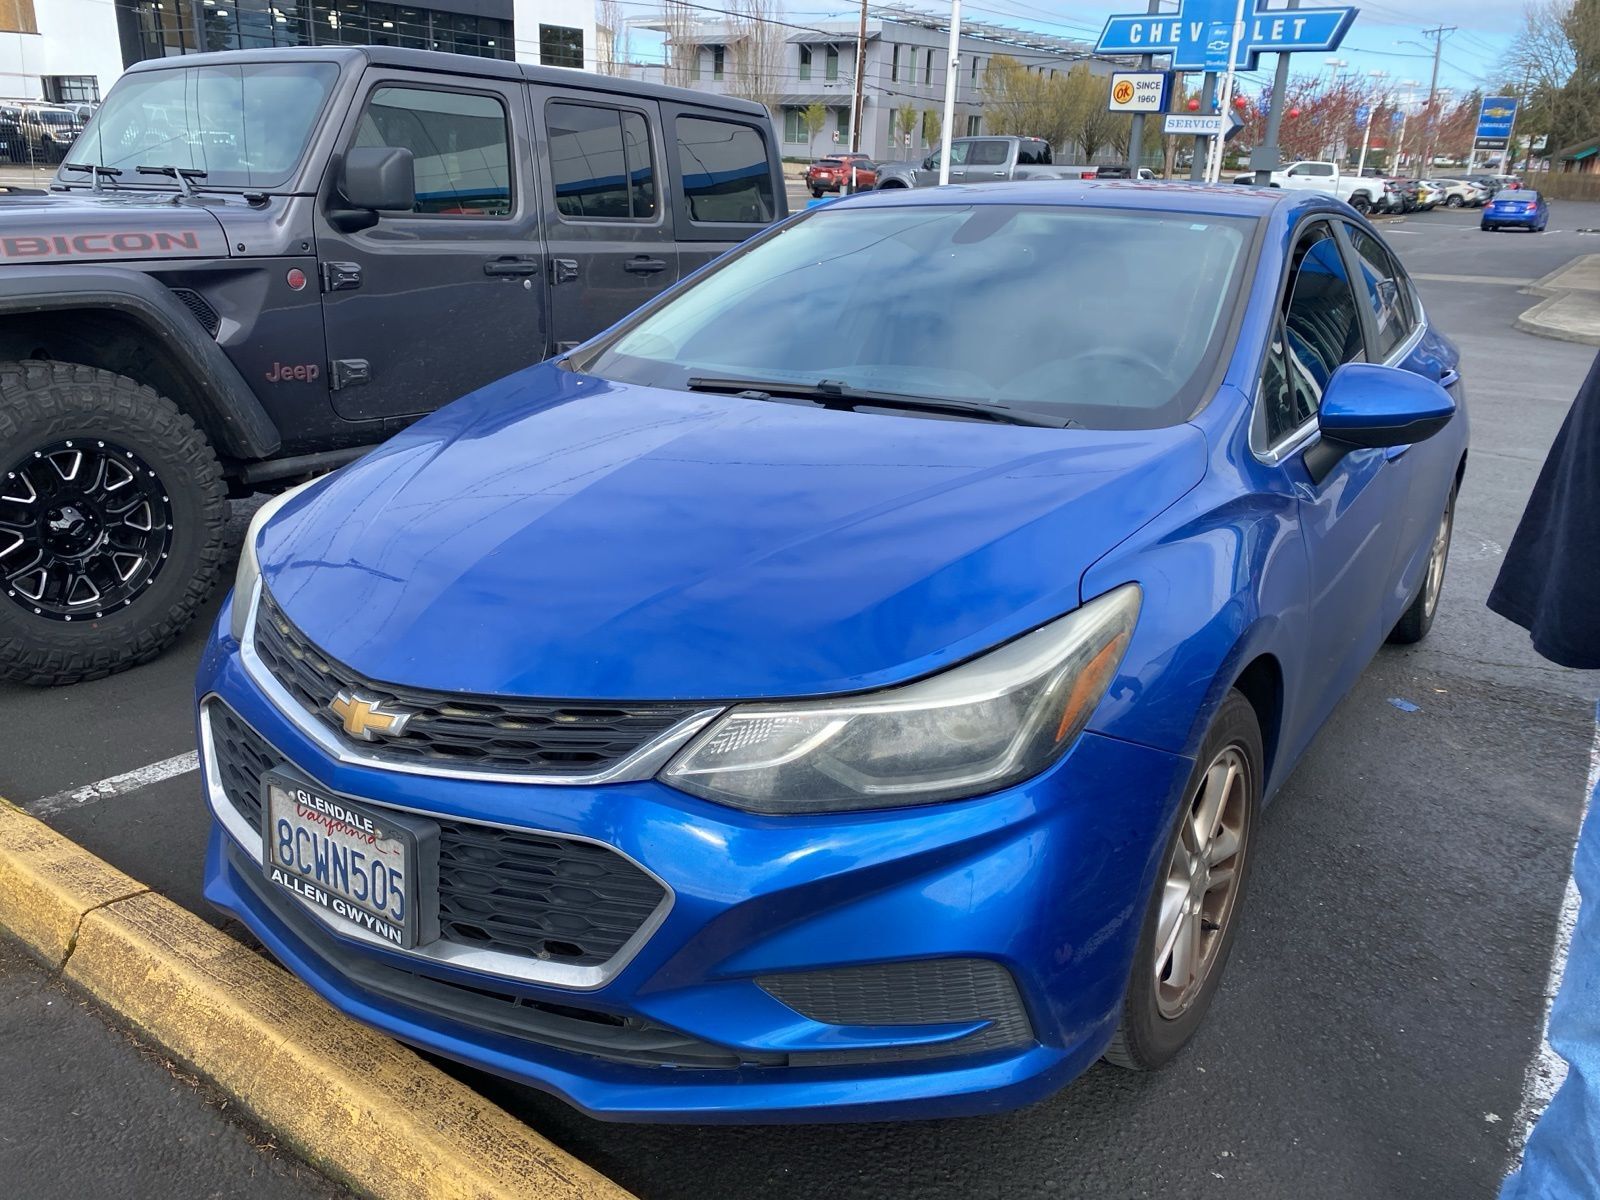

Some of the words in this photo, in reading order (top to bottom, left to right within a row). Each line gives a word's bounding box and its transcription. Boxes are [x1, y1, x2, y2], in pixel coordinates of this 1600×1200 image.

[1130, 18, 1307, 43] CHEVLET
[1116, 84, 1130, 99] OK
[1136, 81, 1161, 90] SINCE
[1137, 95, 1156, 103] 1960
[1167, 119, 1221, 129] SERVICE
[0, 232, 200, 257] BICON
[265, 362, 320, 383] Jeep
[297, 790, 374, 833] GLENDALE
[277, 818, 405, 921] 8CWN505
[271, 869, 328, 906] ALLEN
[332, 898, 402, 944] GWYNN
